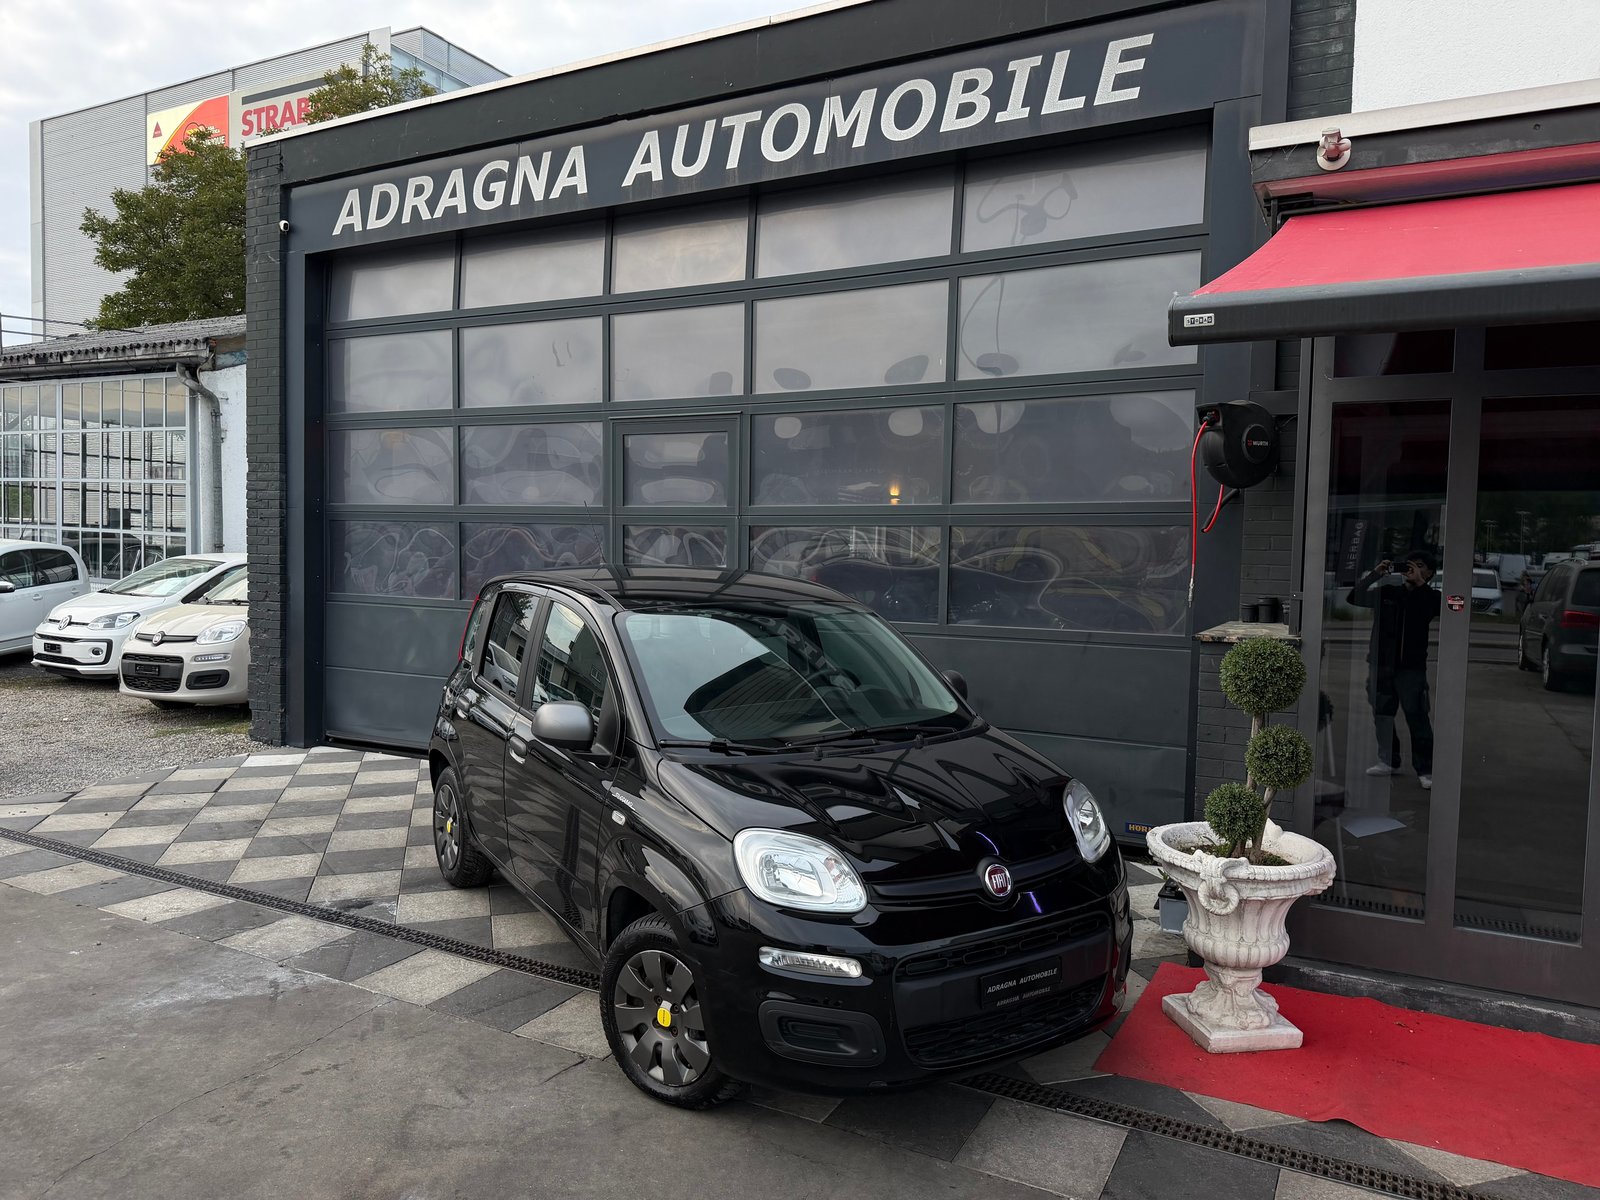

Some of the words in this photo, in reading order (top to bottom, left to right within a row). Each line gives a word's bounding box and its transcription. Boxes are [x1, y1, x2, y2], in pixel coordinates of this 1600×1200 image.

[241, 97, 312, 137] STRAB
[332, 145, 588, 236] ADRAGNA
[621, 32, 1155, 187] AUTOMOBILE
[991, 873, 1007, 889] FIAT
[987, 979, 1017, 994] ADRAGNA
[1019, 968, 1057, 984] AUTOMOBILE
